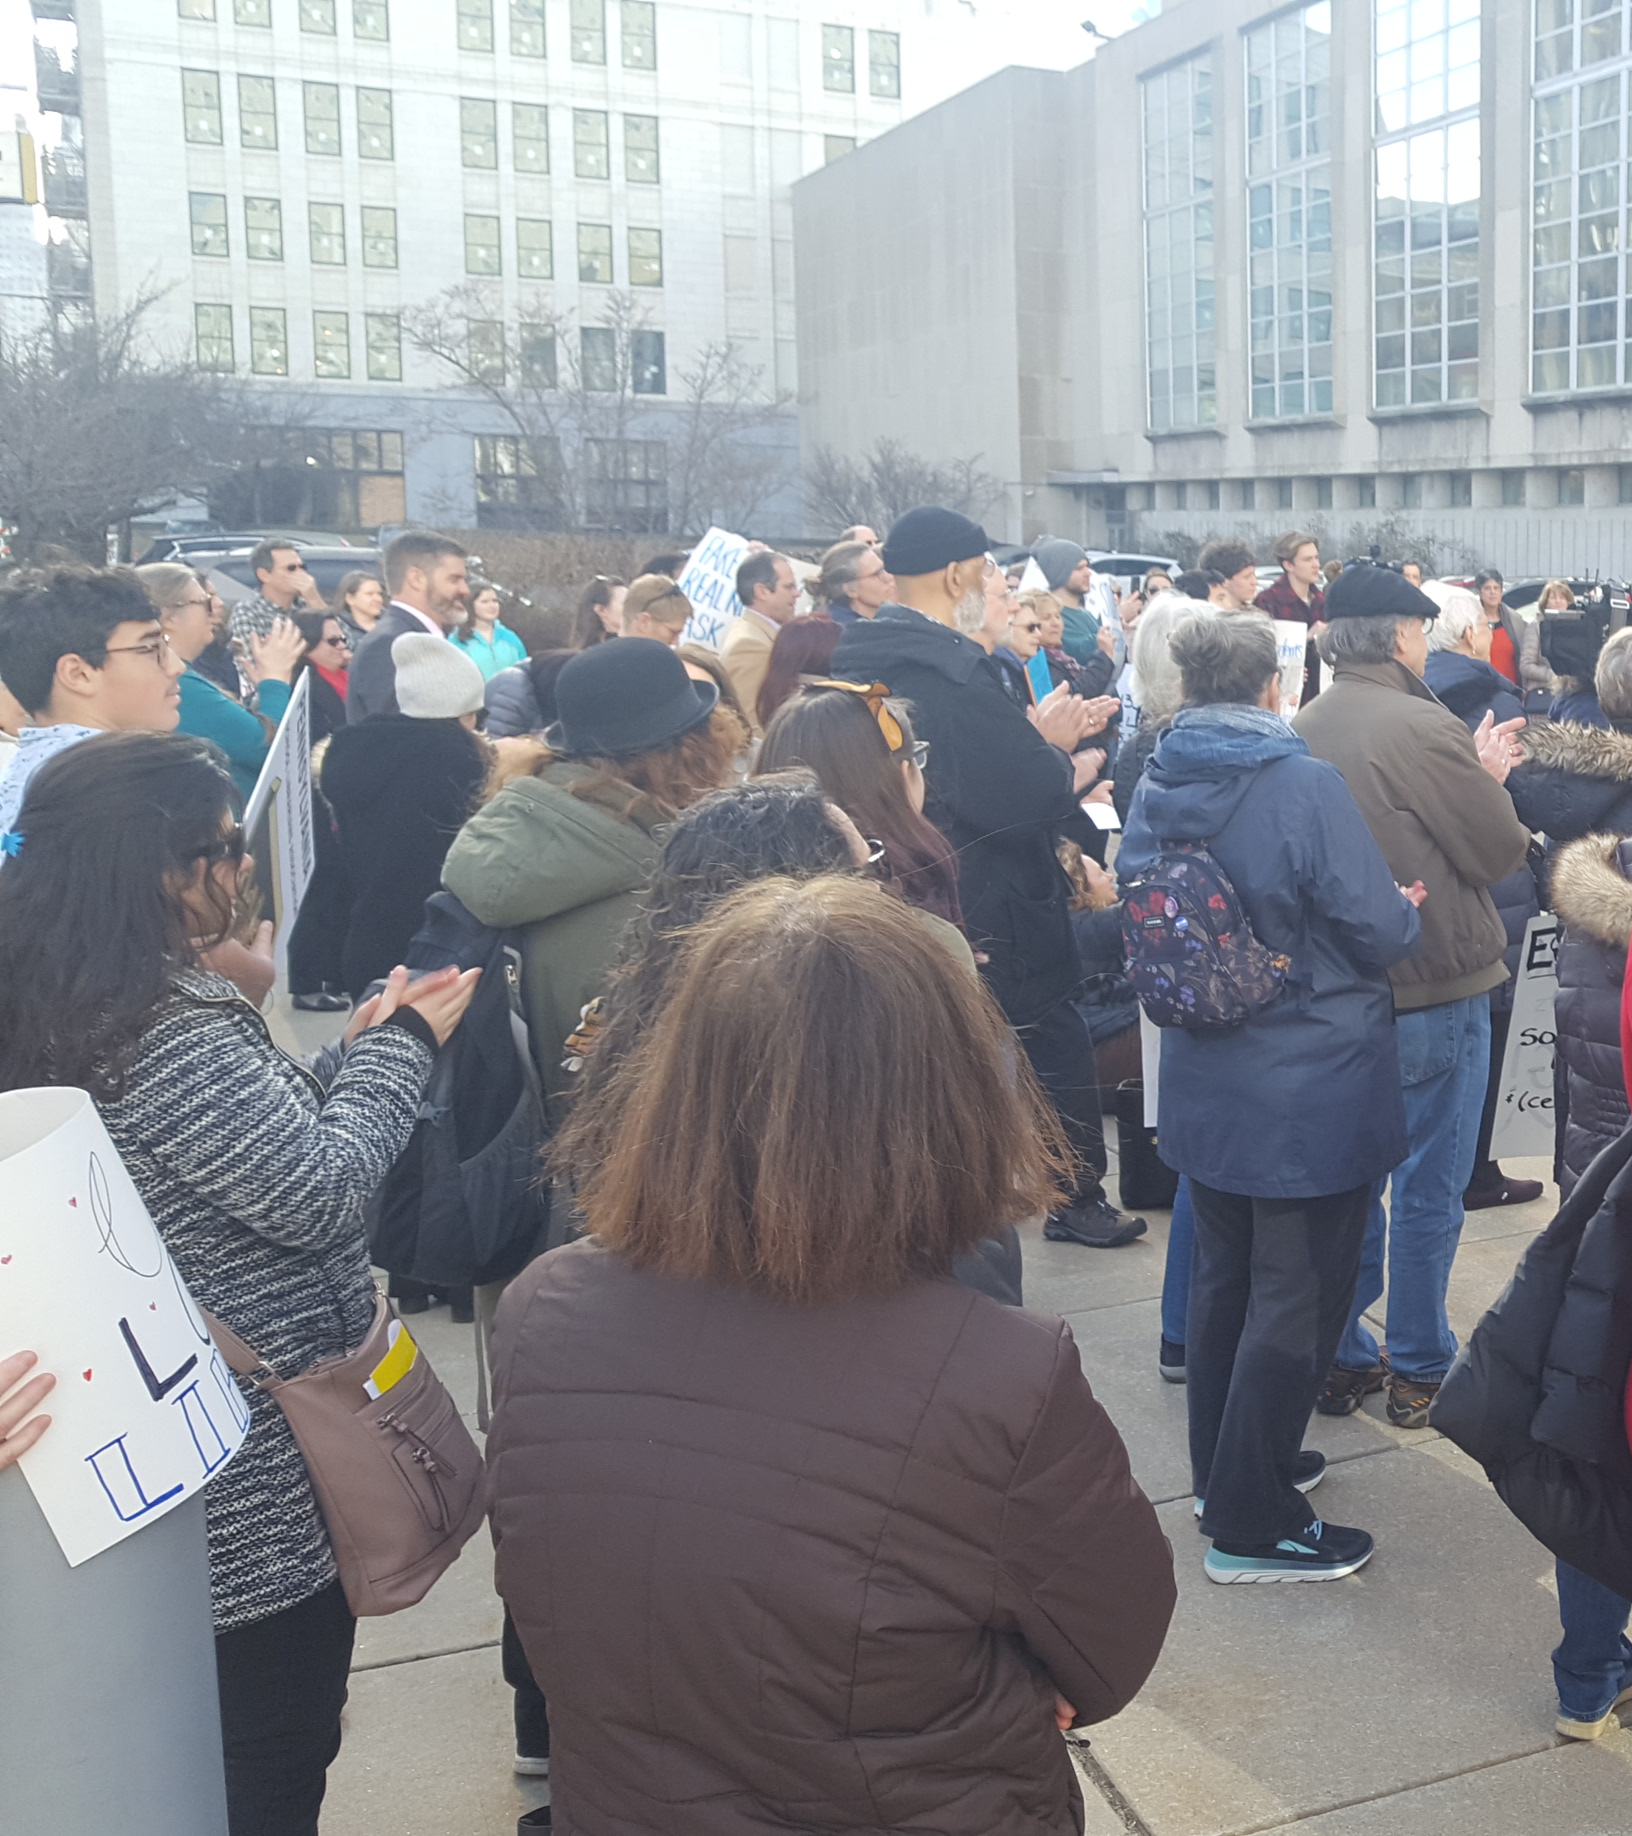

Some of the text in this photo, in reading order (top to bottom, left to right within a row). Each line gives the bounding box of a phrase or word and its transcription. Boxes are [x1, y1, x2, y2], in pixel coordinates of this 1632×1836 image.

[699, 536, 745, 580] FAKE
[681, 566, 726, 612] REAL
[297, 688, 313, 884] PENNSYLVANIA
